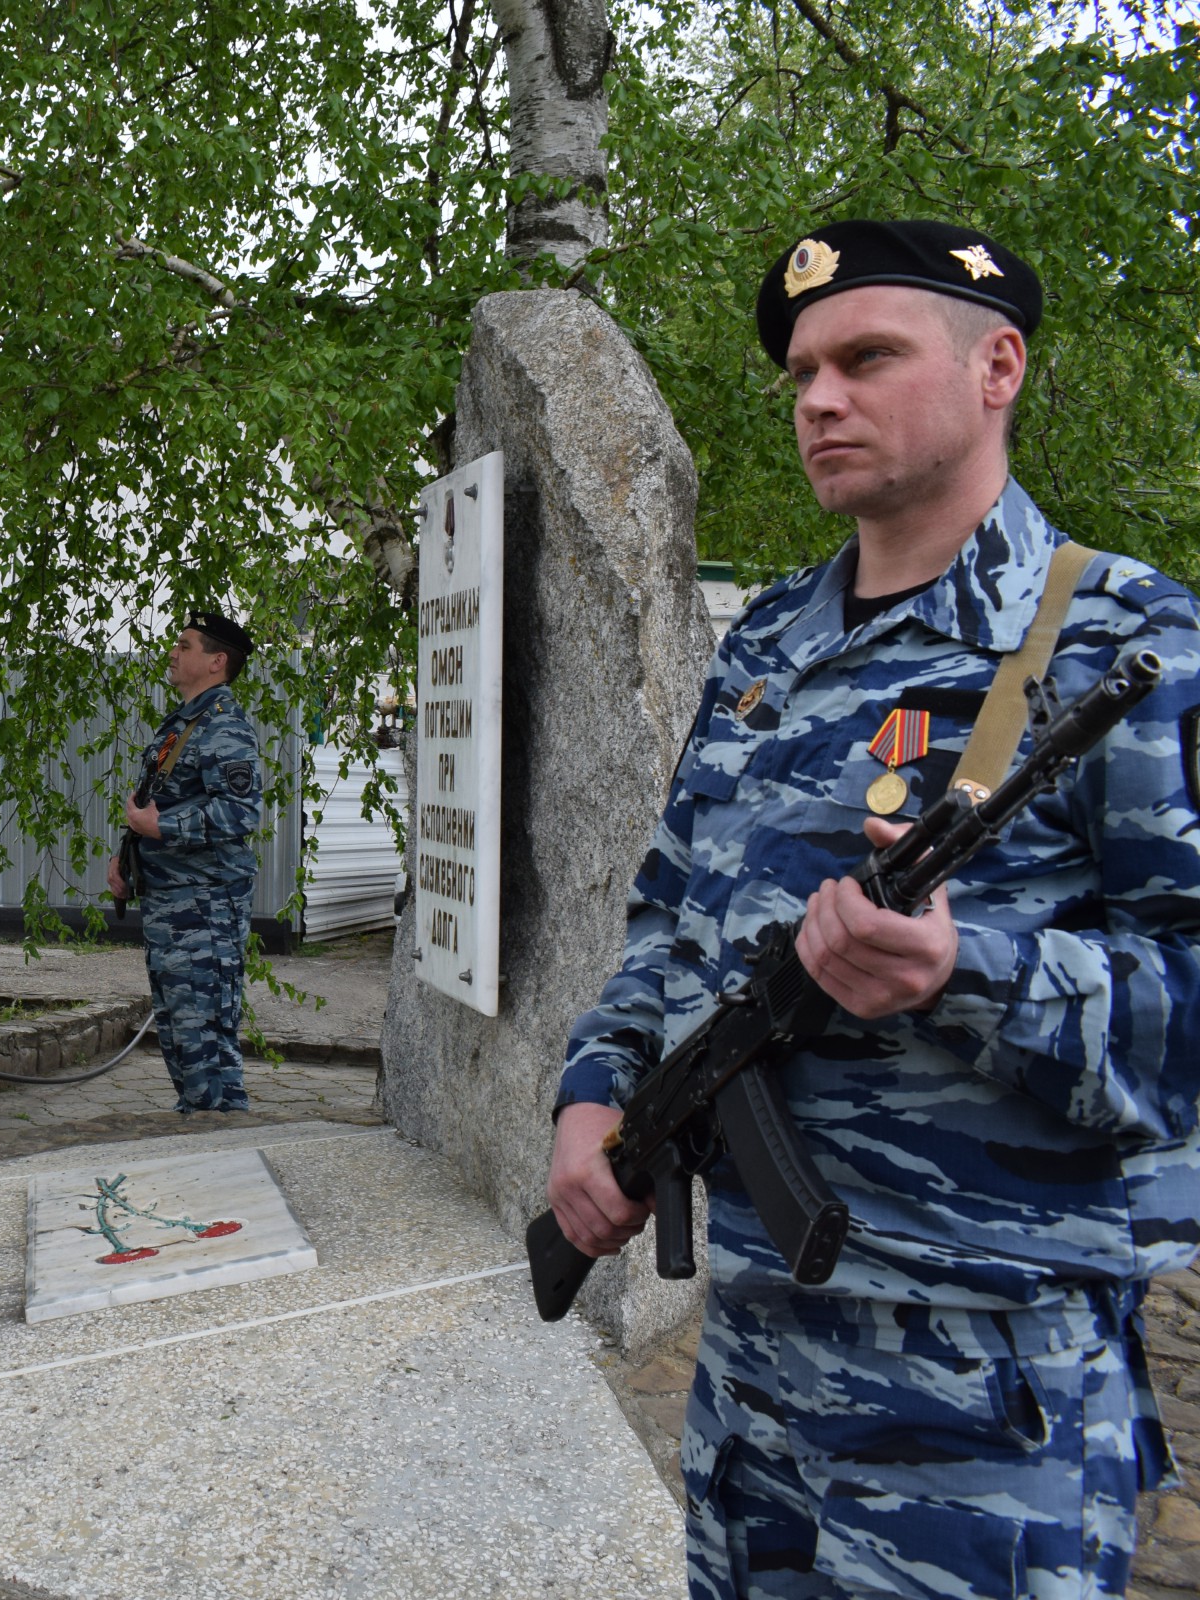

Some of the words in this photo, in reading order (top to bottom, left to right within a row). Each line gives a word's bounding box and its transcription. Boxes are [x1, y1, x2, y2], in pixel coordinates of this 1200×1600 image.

[421, 586, 480, 638] СОТРУДНИКАМ
[431, 645, 463, 687] ОМОН
[425, 698, 472, 738] ПОГИБШИМ
[438, 753, 455, 792] ПРИ
[431, 908, 458, 954] ДОЛГА
